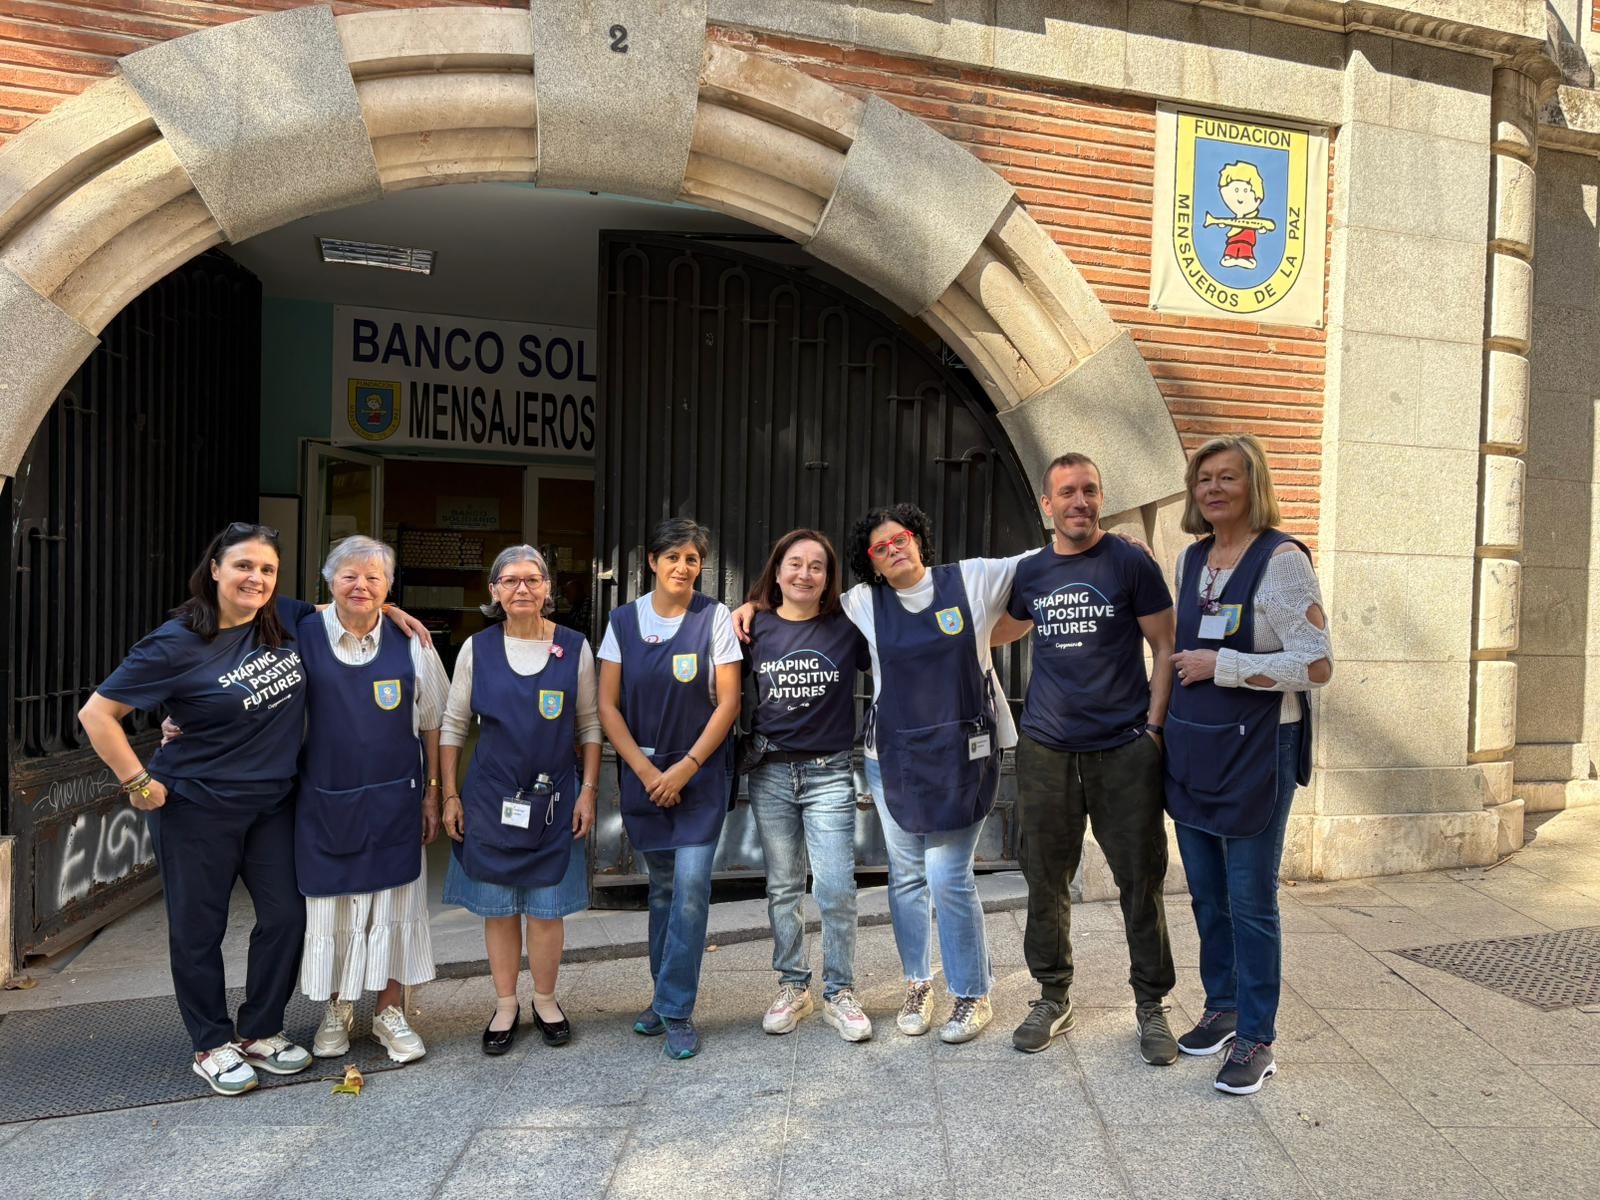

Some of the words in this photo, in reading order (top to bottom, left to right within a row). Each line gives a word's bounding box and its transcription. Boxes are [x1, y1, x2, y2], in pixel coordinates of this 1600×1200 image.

[609, 24, 628, 53] 2
[1194, 119, 1291, 147] FUNDACION
[1289, 206, 1301, 240] PAZ
[1177, 194, 1239, 307] MENSAJEROS
[1281, 255, 1298, 278] LA
[1254, 282, 1276, 305] DE
[352, 318, 504, 374] BANCO
[517, 334, 597, 382] SOL
[409, 381, 595, 451] MENSAJEROS
[1033, 591, 1089, 610] SHAPING
[1047, 605, 1115, 621] POSITIVE
[1037, 620, 1098, 636] FUTURES
[218, 651, 277, 688] SHAPING
[249, 652, 301, 689] POSITIVE
[760, 658, 819, 674] SHAPING
[778, 671, 840, 685] POSITIVE
[243, 670, 302, 710] FUTURES
[768, 685, 826, 699] FUTURES
